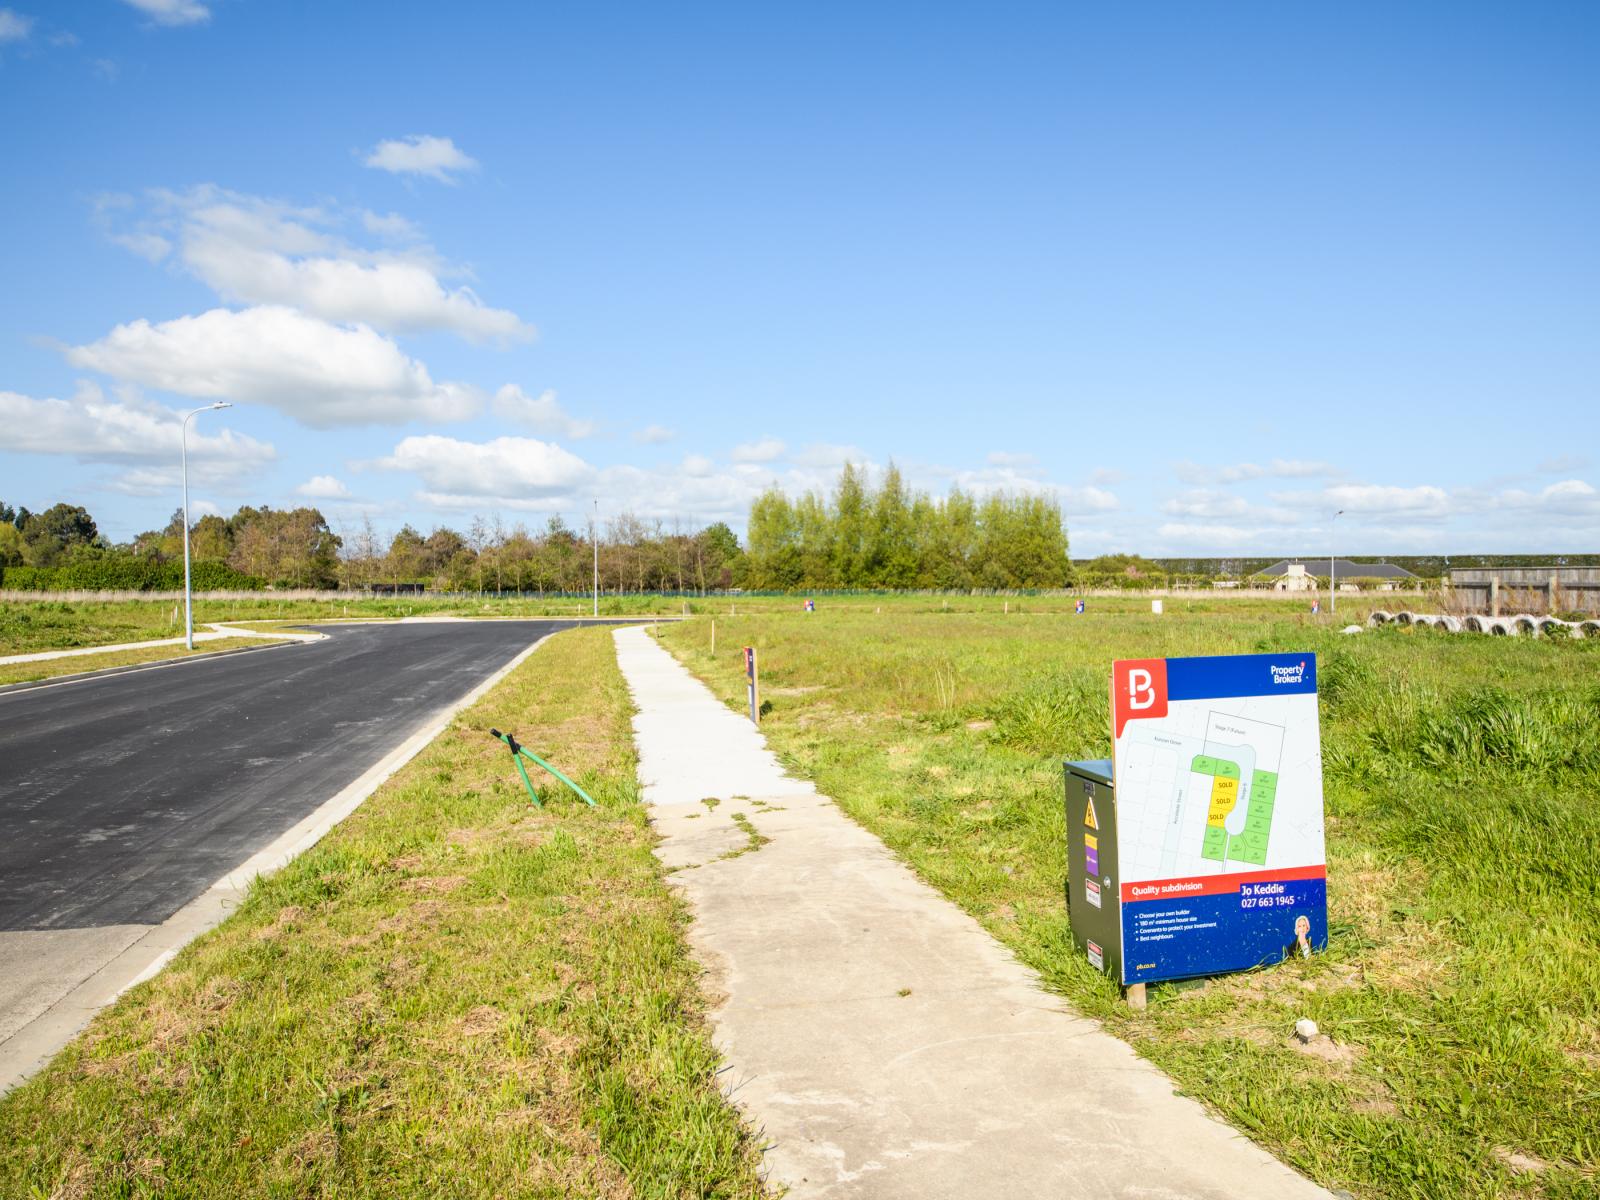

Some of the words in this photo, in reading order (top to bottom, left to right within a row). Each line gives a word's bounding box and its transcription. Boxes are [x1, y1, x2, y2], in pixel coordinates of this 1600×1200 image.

[1271, 665, 1304, 676] Property
[1274, 674, 1302, 684] Brokers
[1132, 885, 1160, 897] Quality
[1161, 881, 1203, 893] subdivision
[1241, 885, 1251, 896] Jo
[1254, 884, 1284, 894] Keddie
[1241, 898, 1257, 909] 027
[1258, 897, 1274, 908] 663
[1275, 895, 1295, 907] 1945
